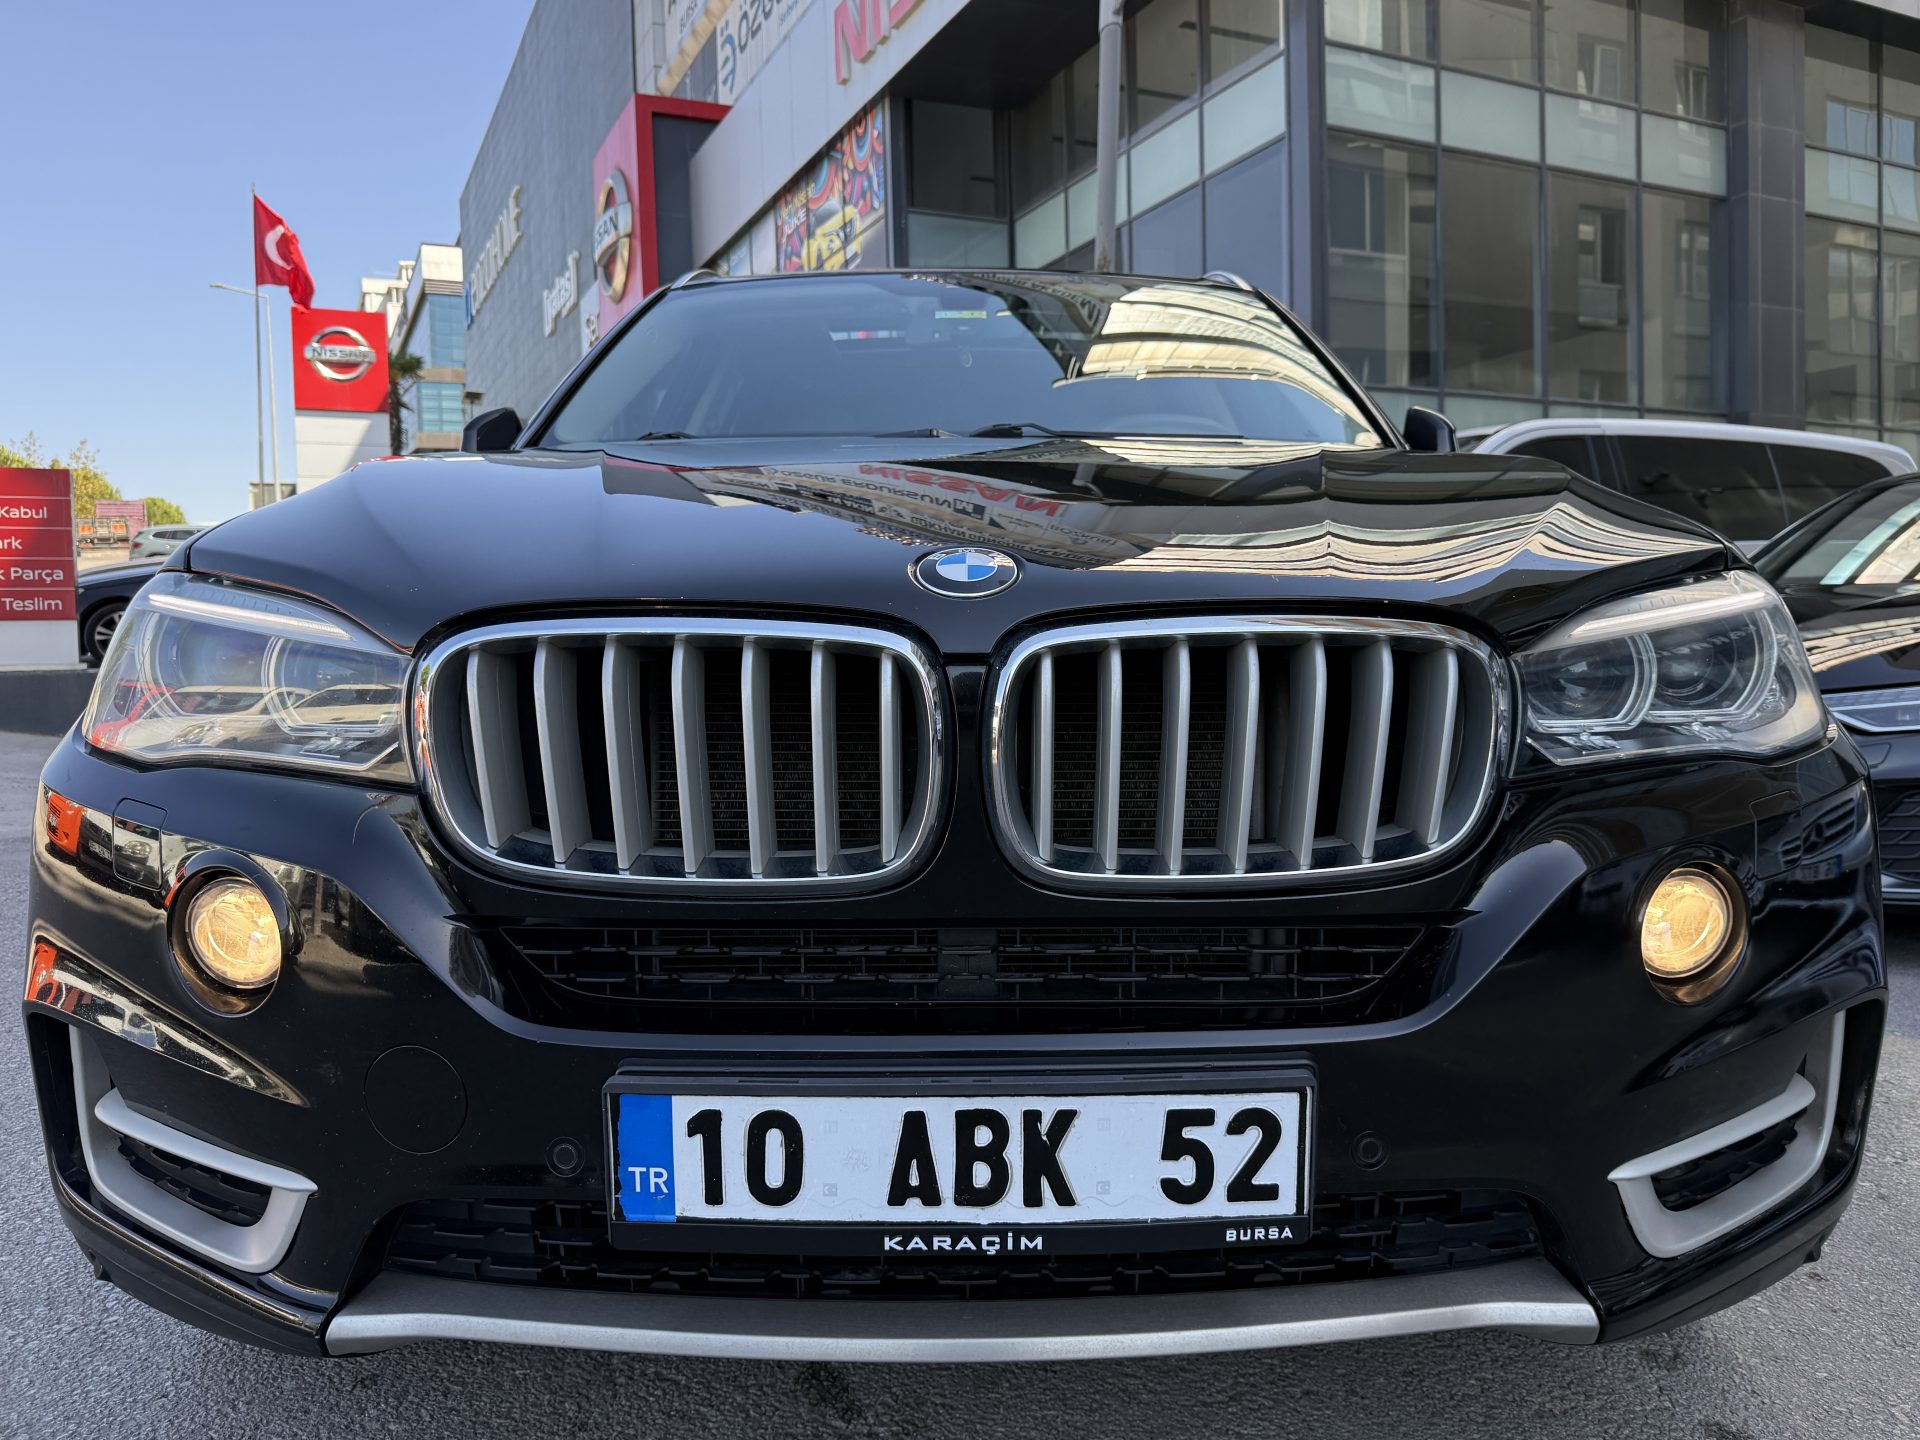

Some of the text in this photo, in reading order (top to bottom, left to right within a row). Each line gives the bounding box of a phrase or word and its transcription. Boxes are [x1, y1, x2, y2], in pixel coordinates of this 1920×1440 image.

[0, 505, 48, 519] Kabul
[10, 567, 64, 584] Parça
[1, 597, 63, 612] Teslim
[686, 1106, 1283, 1208] 10 ABK 52
[627, 1166, 669, 1193] TR
[1225, 1226, 1293, 1243] BURSA
[883, 1232, 1044, 1255] KARAÇİM
